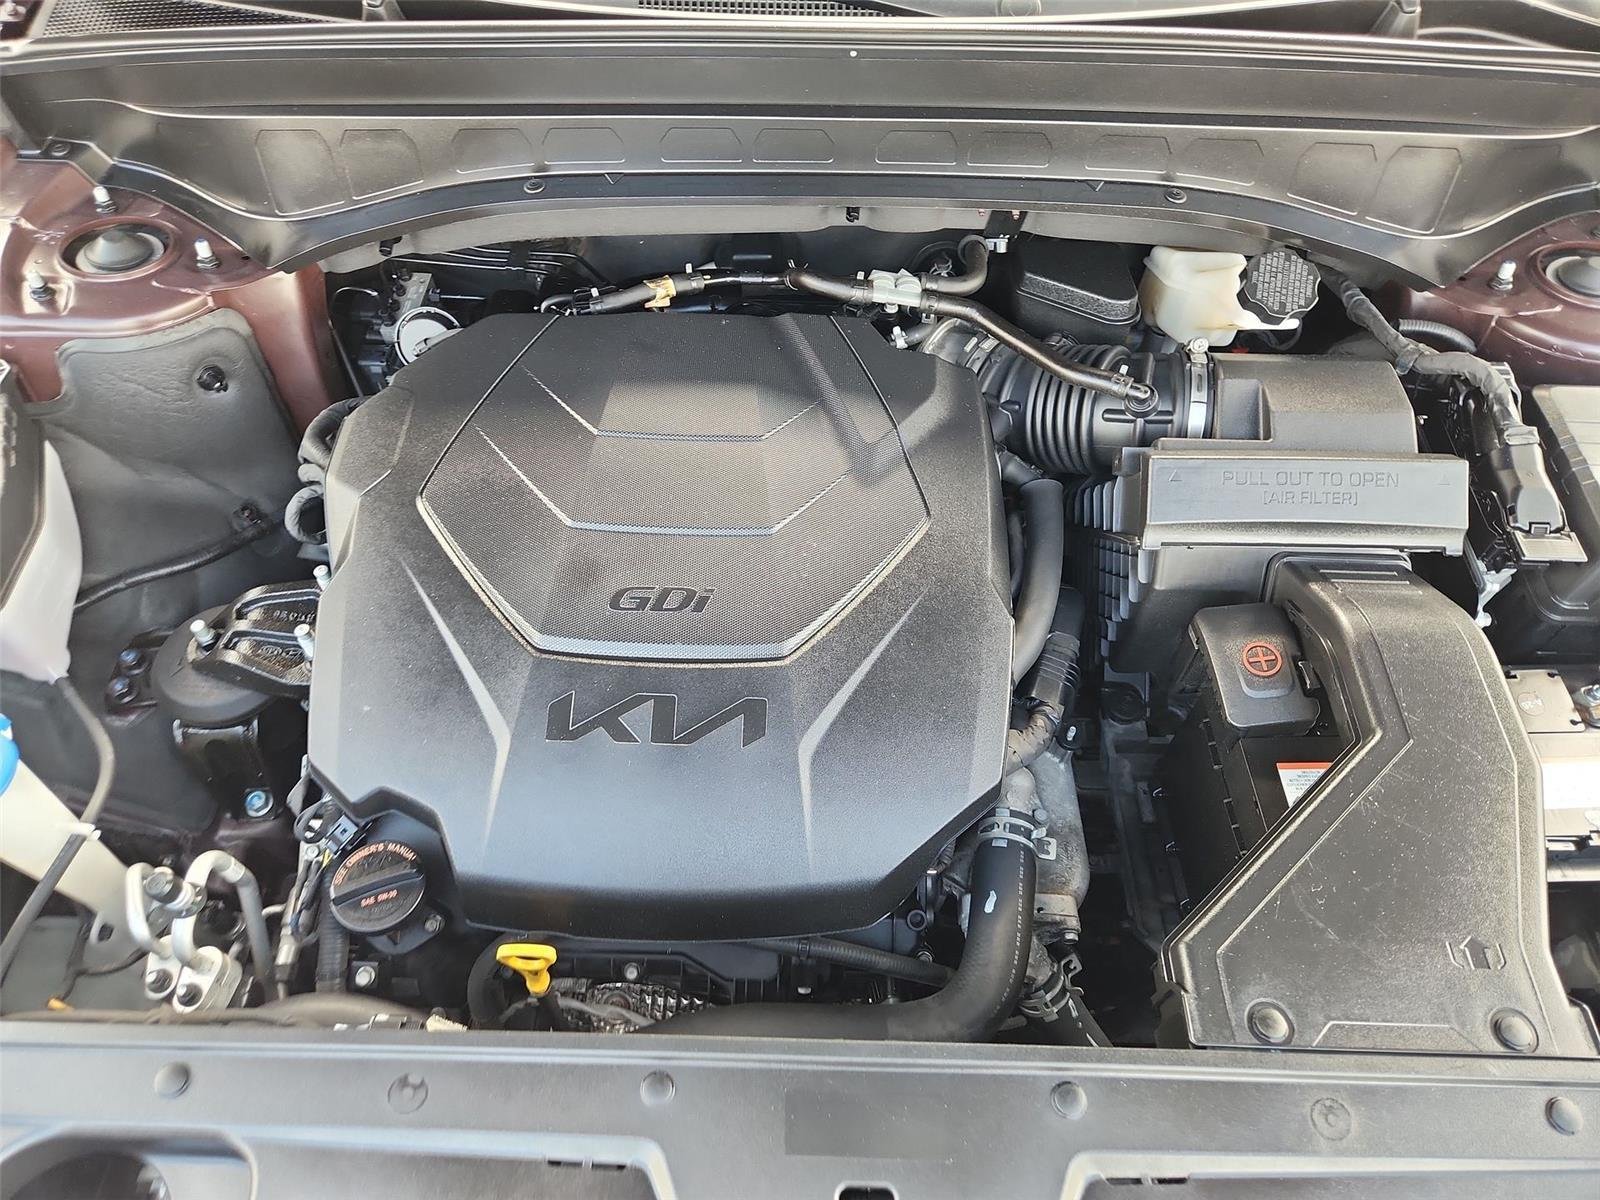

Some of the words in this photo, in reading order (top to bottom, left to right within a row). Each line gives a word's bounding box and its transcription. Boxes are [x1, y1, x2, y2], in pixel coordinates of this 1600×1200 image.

[1222, 470, 1269, 487] PULL
[1276, 471, 1314, 487] OUT
[1319, 471, 1343, 487] TO
[1350, 472, 1400, 488] OPEN
[608, 585, 717, 614] GDi
